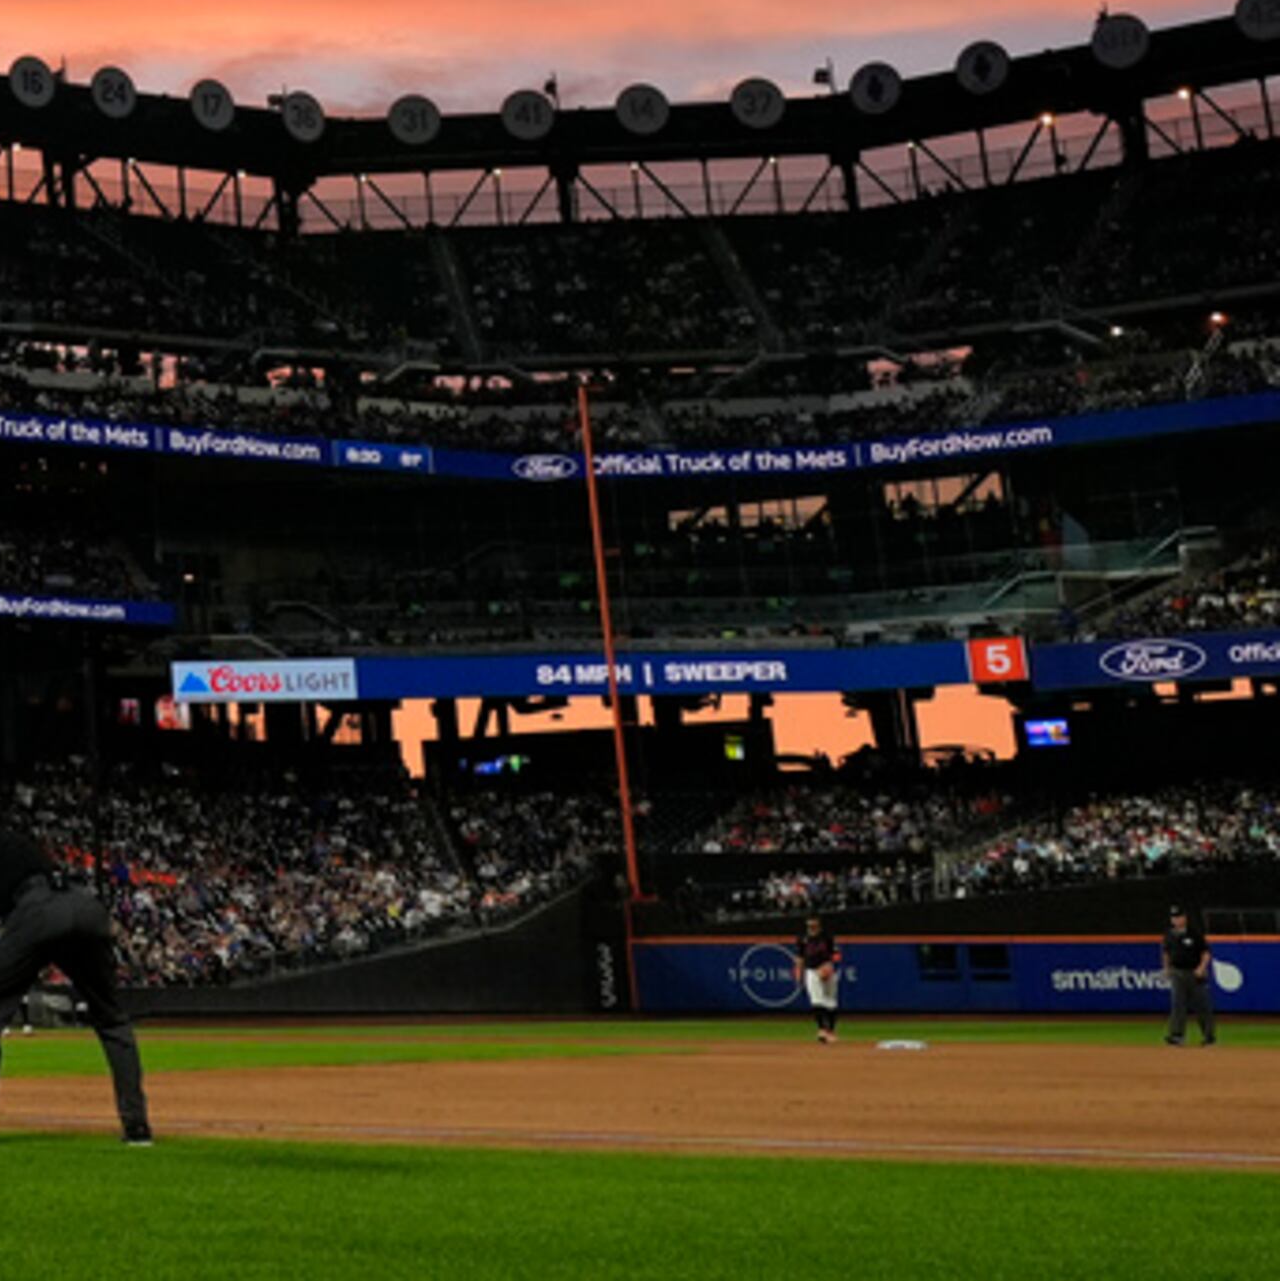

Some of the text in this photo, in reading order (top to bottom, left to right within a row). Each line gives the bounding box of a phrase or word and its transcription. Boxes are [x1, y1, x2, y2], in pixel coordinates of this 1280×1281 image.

[102, 78, 127, 104] 24
[203, 92, 223, 117] 17
[743, 89, 772, 117] 37
[46, 421, 66, 439] of
[70, 424, 100, 443] the
[105, 426, 148, 447] Mets
[170, 430, 320, 459] BuyFordNow.com
[666, 454, 725, 471] Truck
[728, 452, 751, 470] of
[755, 452, 792, 470] the
[796, 451, 846, 468] Mets
[871, 427, 1052, 462] BuyFordNow.com
[537, 665, 572, 684] 84
[665, 661, 786, 682] SWEEPER
[986, 646, 1012, 674] 5
[208, 666, 352, 694] Coors LIGHT
